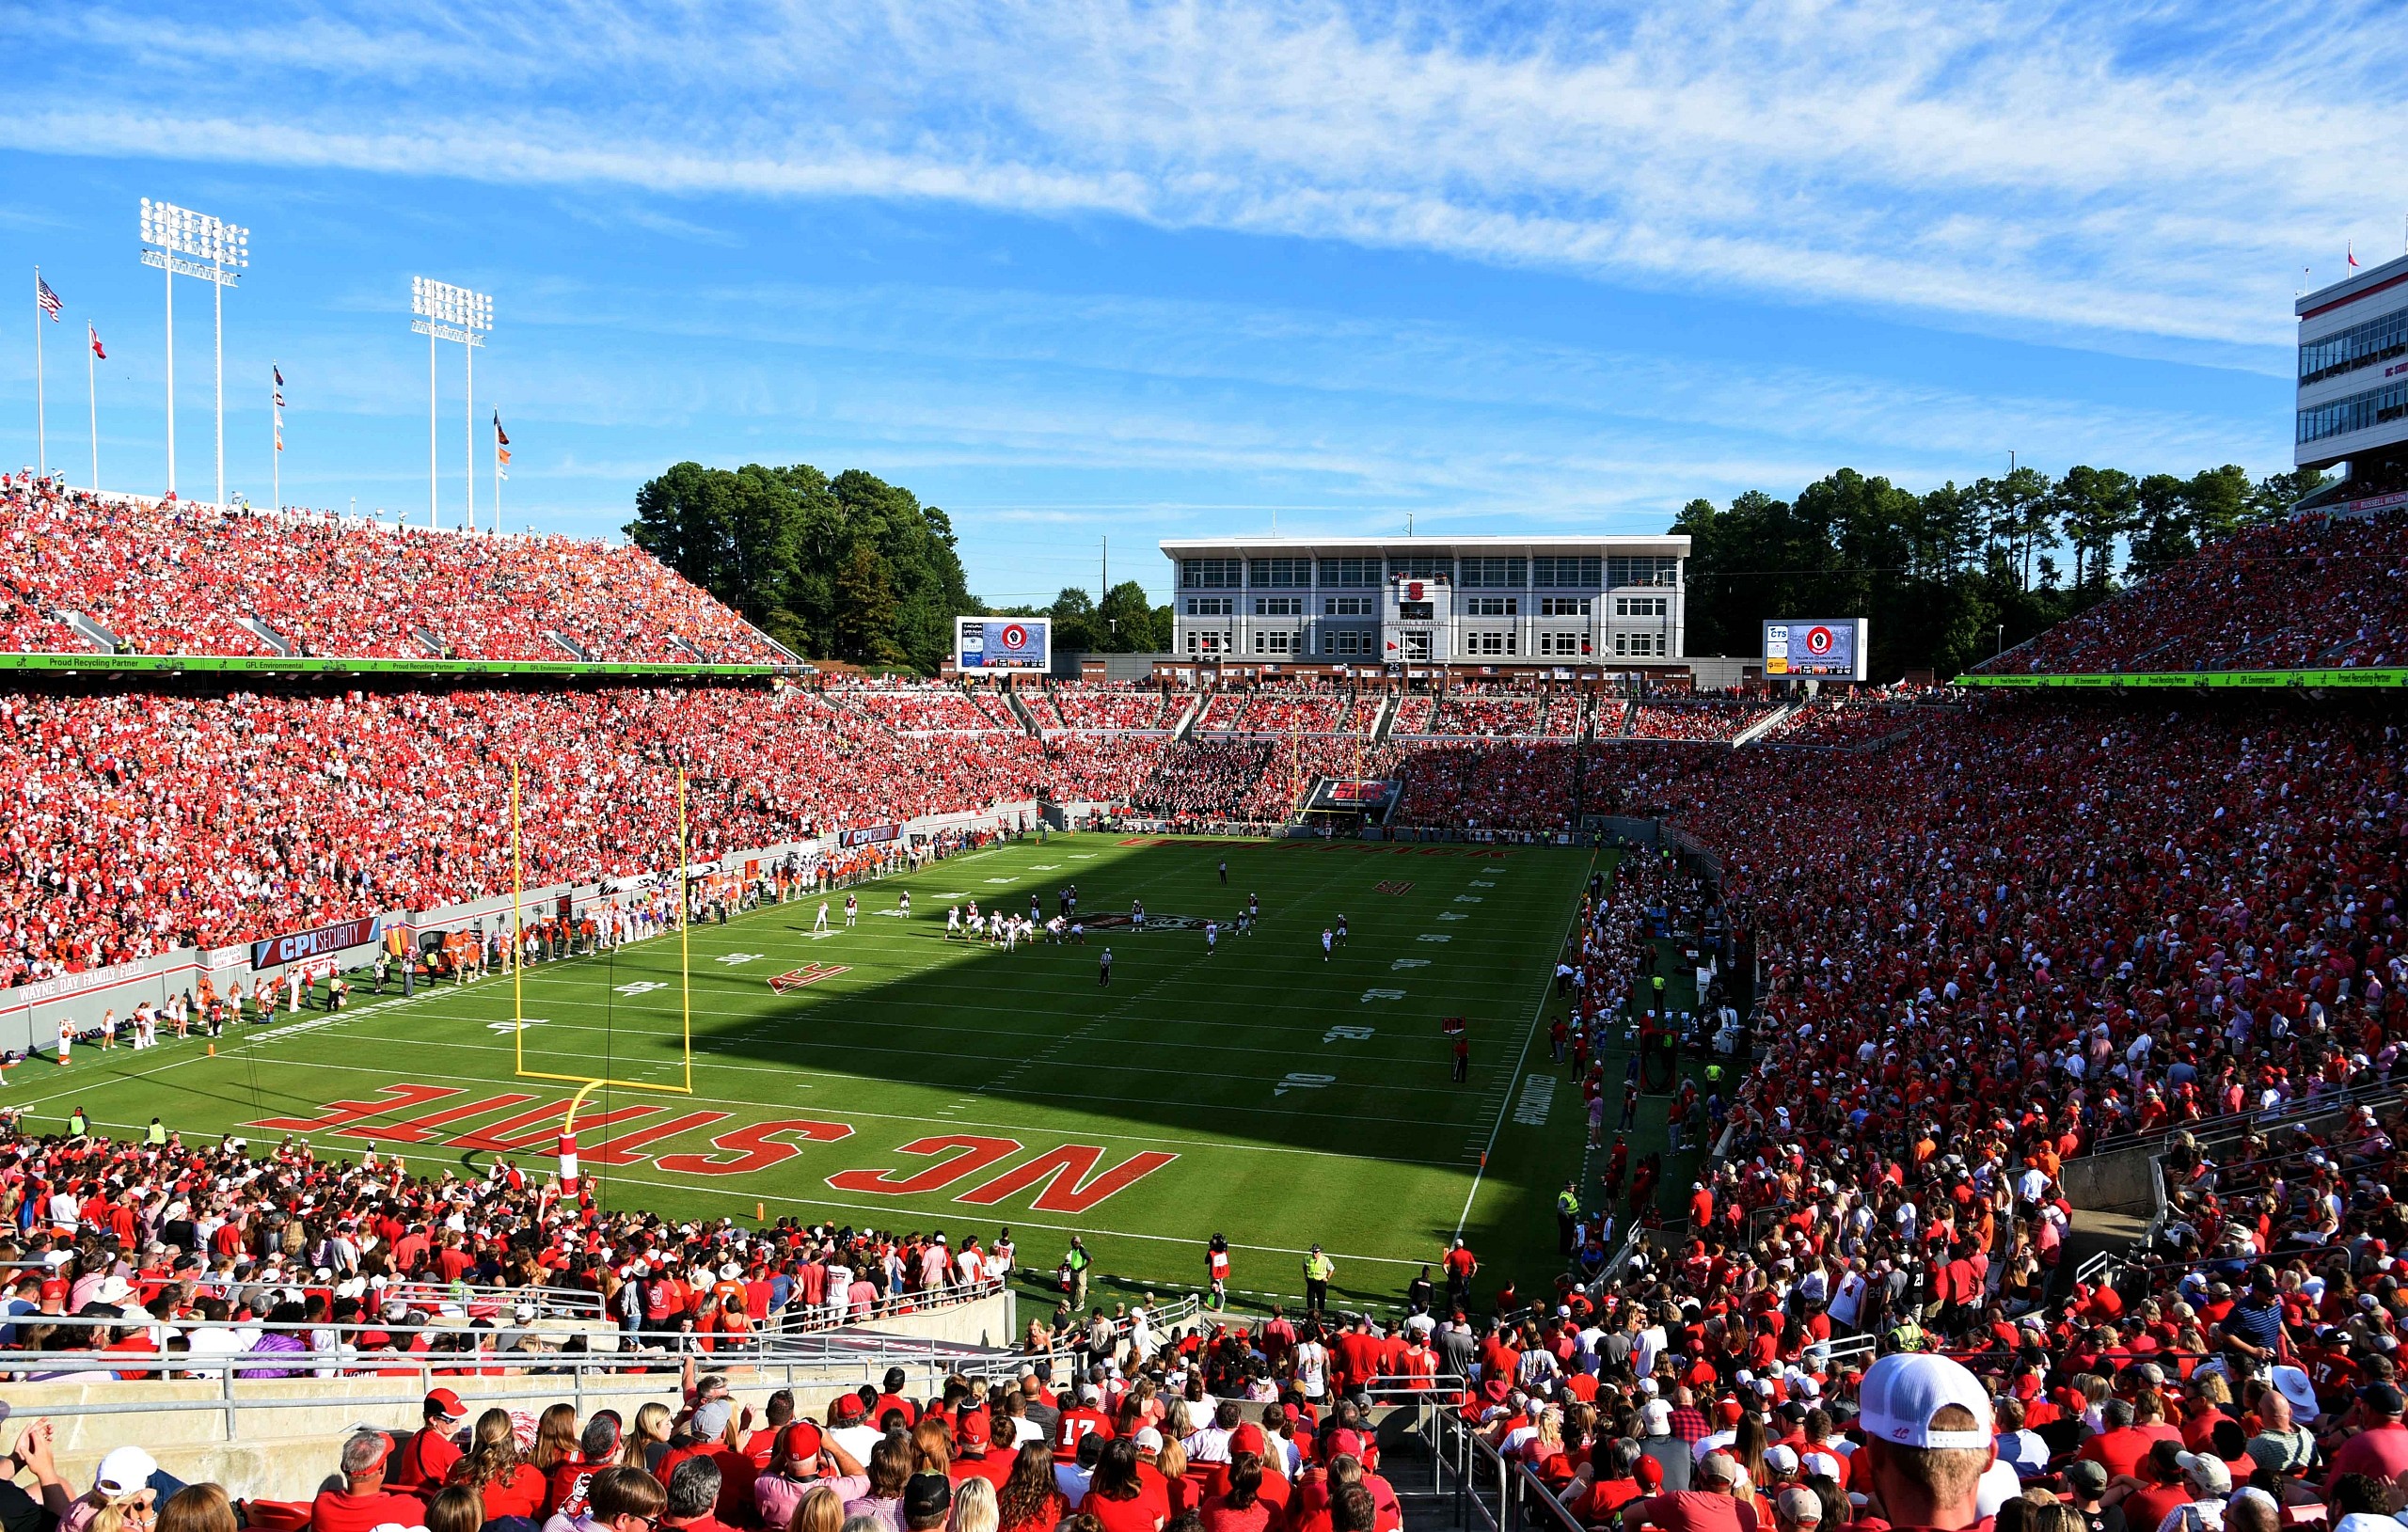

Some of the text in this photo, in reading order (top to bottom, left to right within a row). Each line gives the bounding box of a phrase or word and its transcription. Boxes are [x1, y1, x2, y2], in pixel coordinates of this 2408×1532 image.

[2361, 493, 2406, 509] RUSSELL WILSON
[50, 658, 72, 667] Proud
[74, 658, 110, 669] Recycling
[260, 661, 304, 670] Environmental
[410, 663, 435, 671] Recycling
[531, 663, 573, 671] GFL Environmental
[853, 825, 894, 844] CPI SECURITY
[279, 924, 359, 960] CPI SECURITY
[18, 961, 144, 1002] WAYNE DAY FAMILY FIELD
[767, 961, 854, 995] ACC
[613, 981, 1375, 1040] 20 20
[244, 1014, 349, 1041] STRENGTH
[1277, 1073, 1337, 1088] 10
[234, 1082, 1182, 1214] NC STATE
[1913, 1272, 1925, 1287] 21
[1868, 1286, 1882, 1299] 24
[2312, 1361, 2333, 1384] 17
[1062, 1418, 1096, 1445] 17
